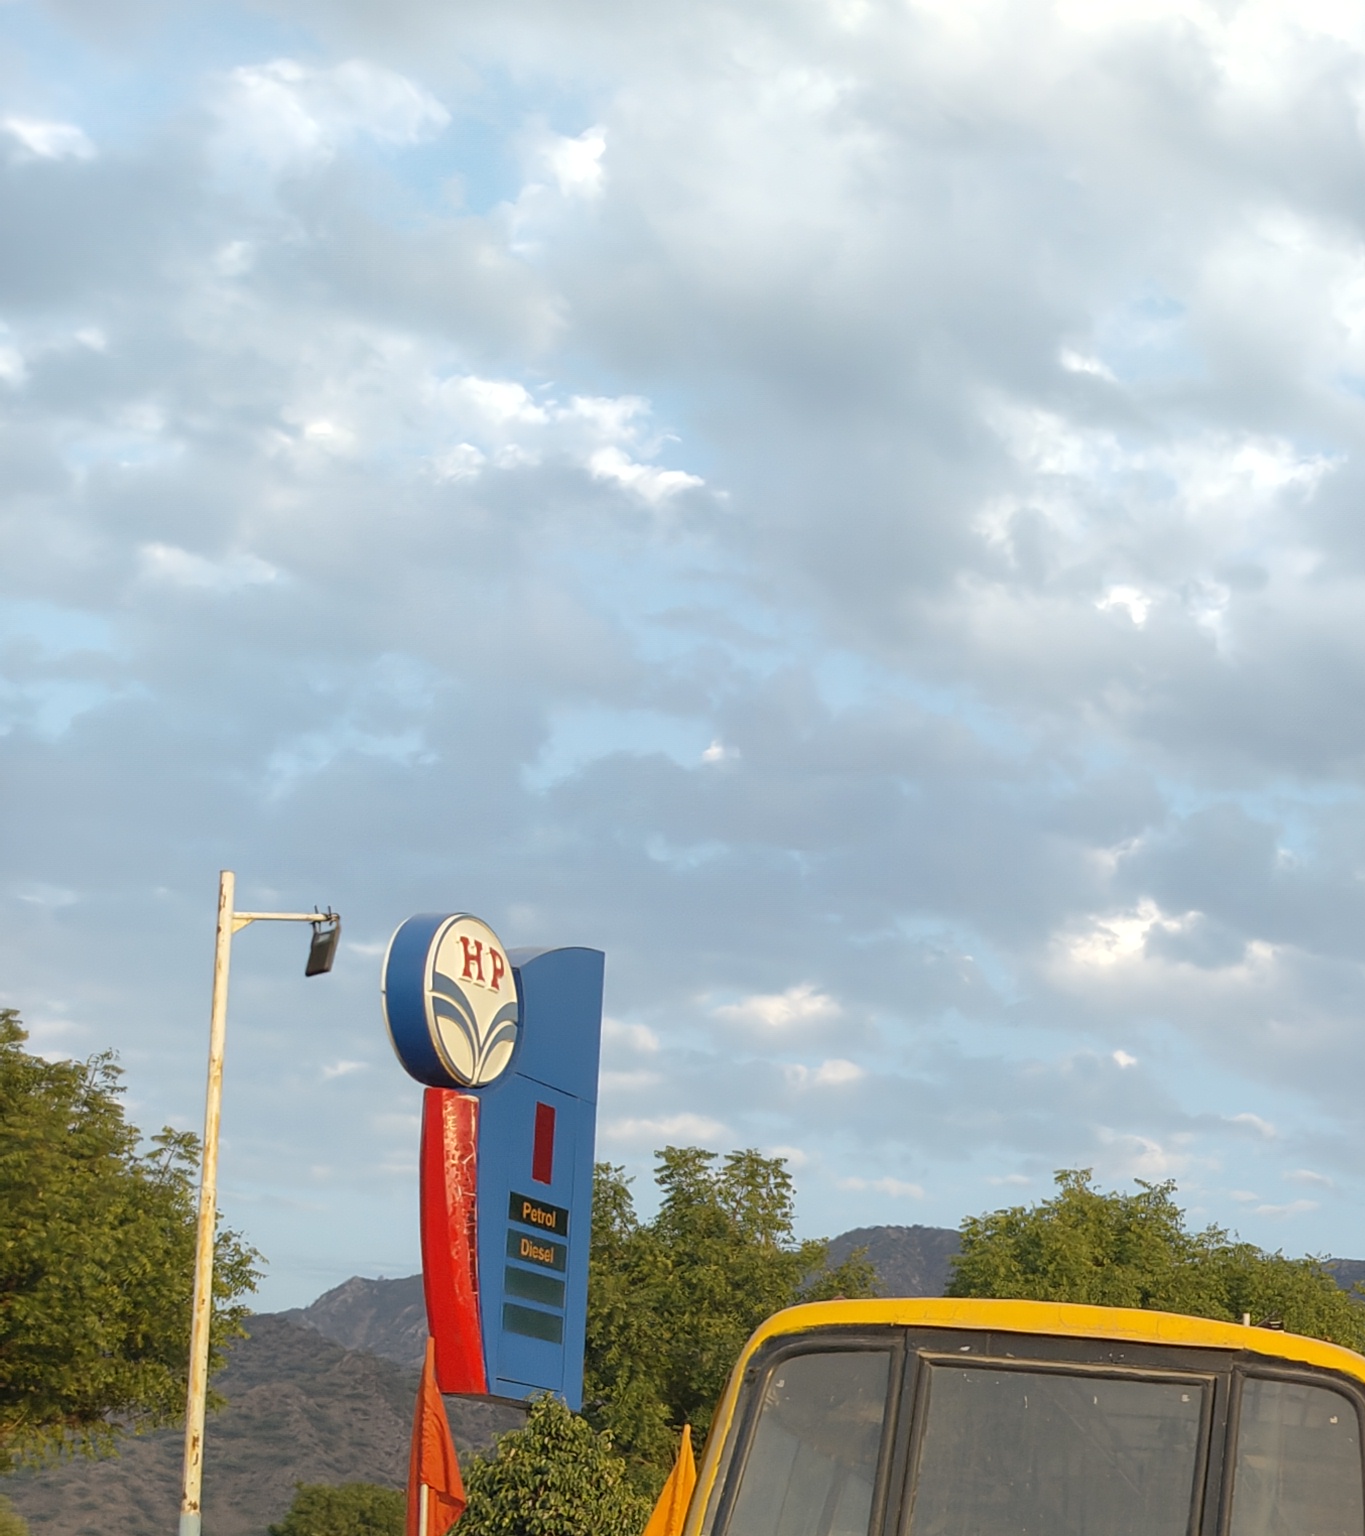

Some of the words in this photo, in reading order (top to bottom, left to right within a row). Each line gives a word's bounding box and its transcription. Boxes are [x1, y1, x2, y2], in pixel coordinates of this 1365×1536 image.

[459, 935, 505, 991] HP
[522, 1201, 557, 1228] Petrol
[520, 1238, 555, 1263] Diesel
